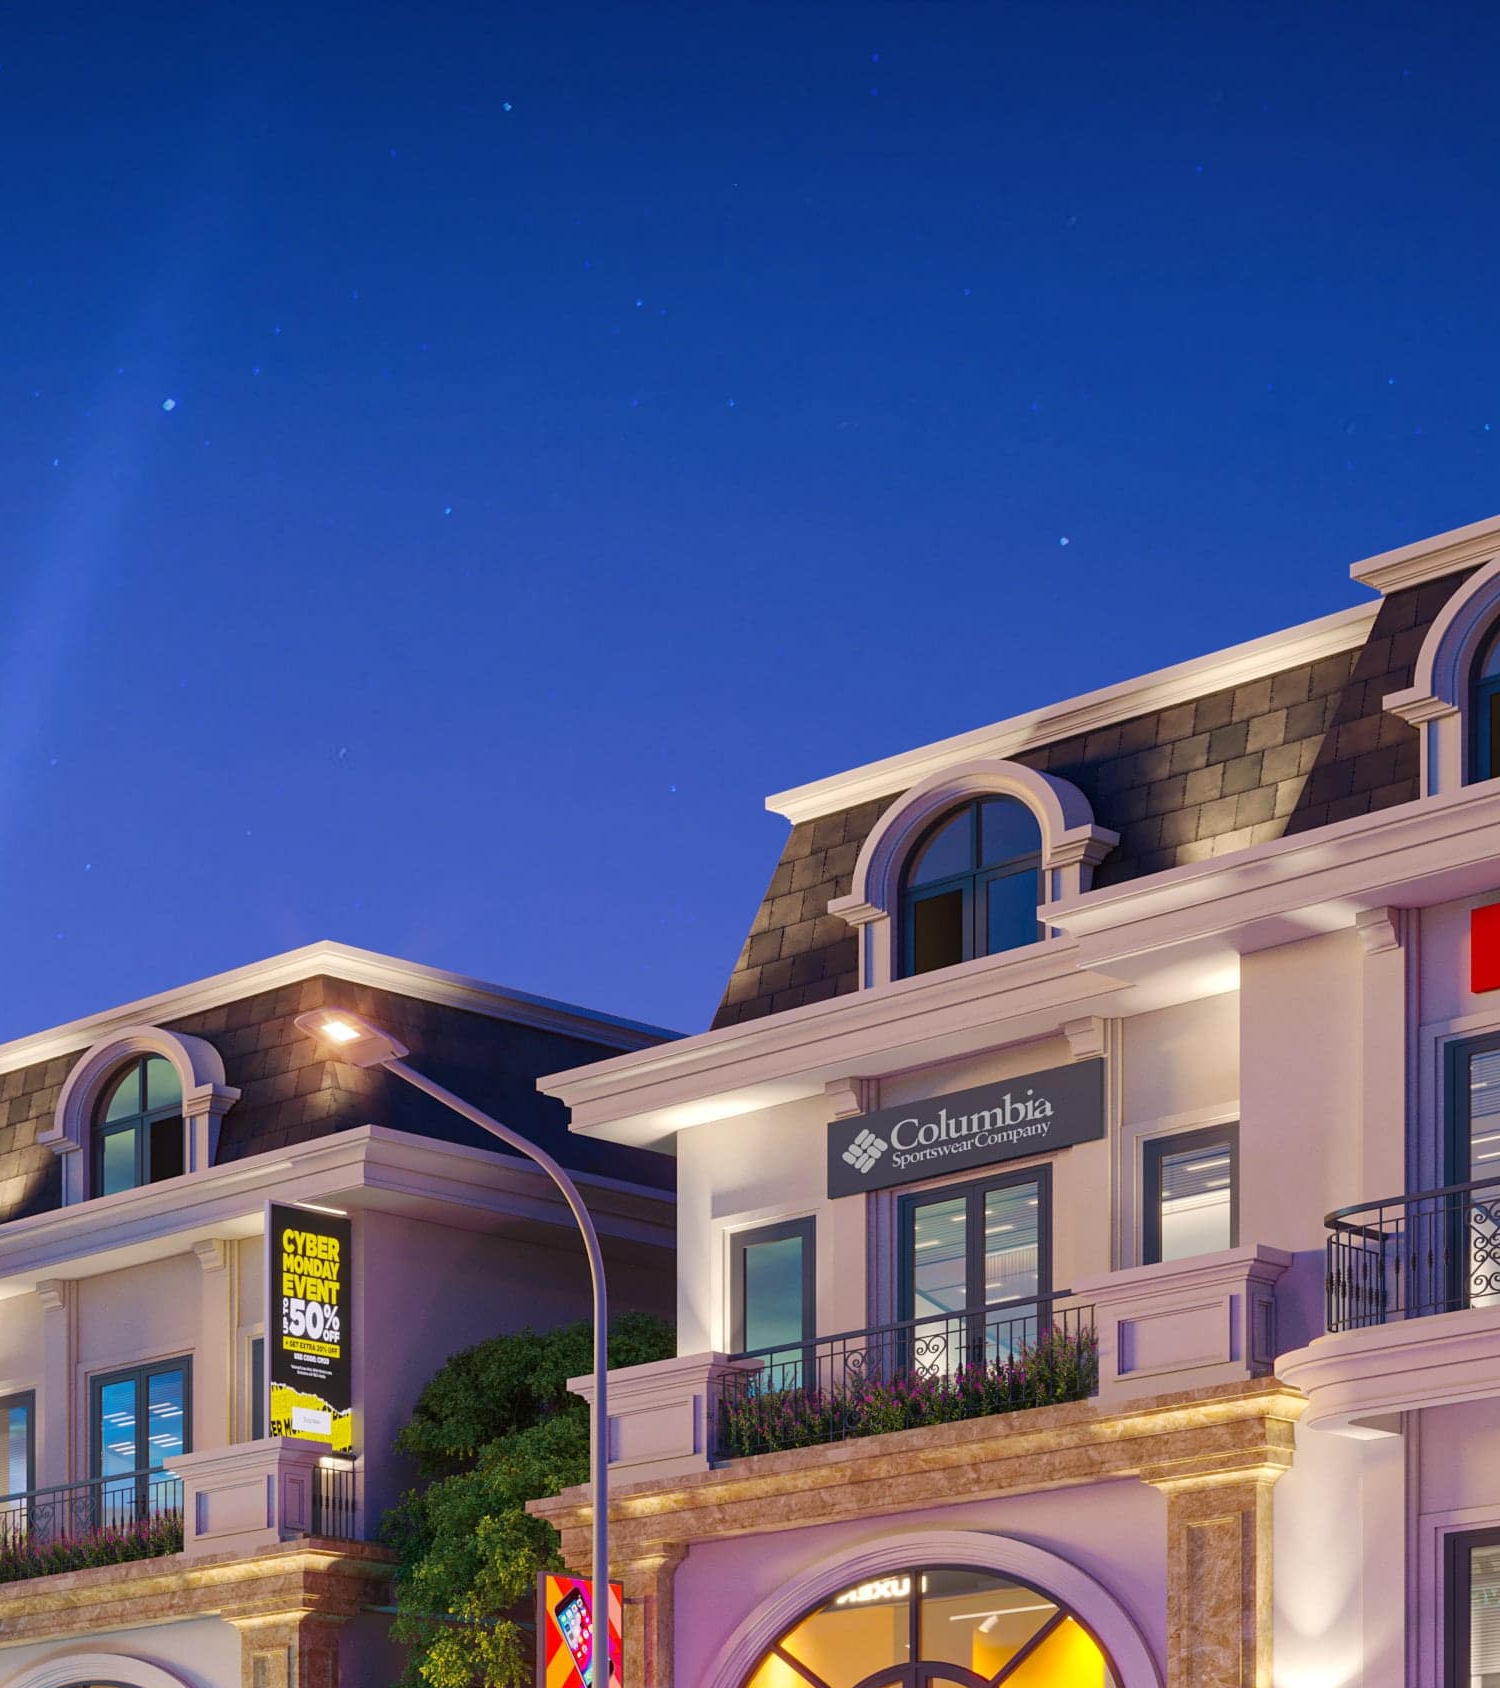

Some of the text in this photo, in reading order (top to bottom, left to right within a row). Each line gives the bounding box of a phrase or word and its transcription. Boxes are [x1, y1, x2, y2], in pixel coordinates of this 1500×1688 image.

[891, 1089, 1054, 1151] Columbia
[892, 1122, 1051, 1169] Sportswear Company
[283, 1228, 340, 1262] CYBER
[283, 1252, 340, 1281] MONDAY
[283, 1272, 340, 1305] EVENT
[289, 1297, 340, 1340] 50%
[323, 1329, 340, 1343] OFF
